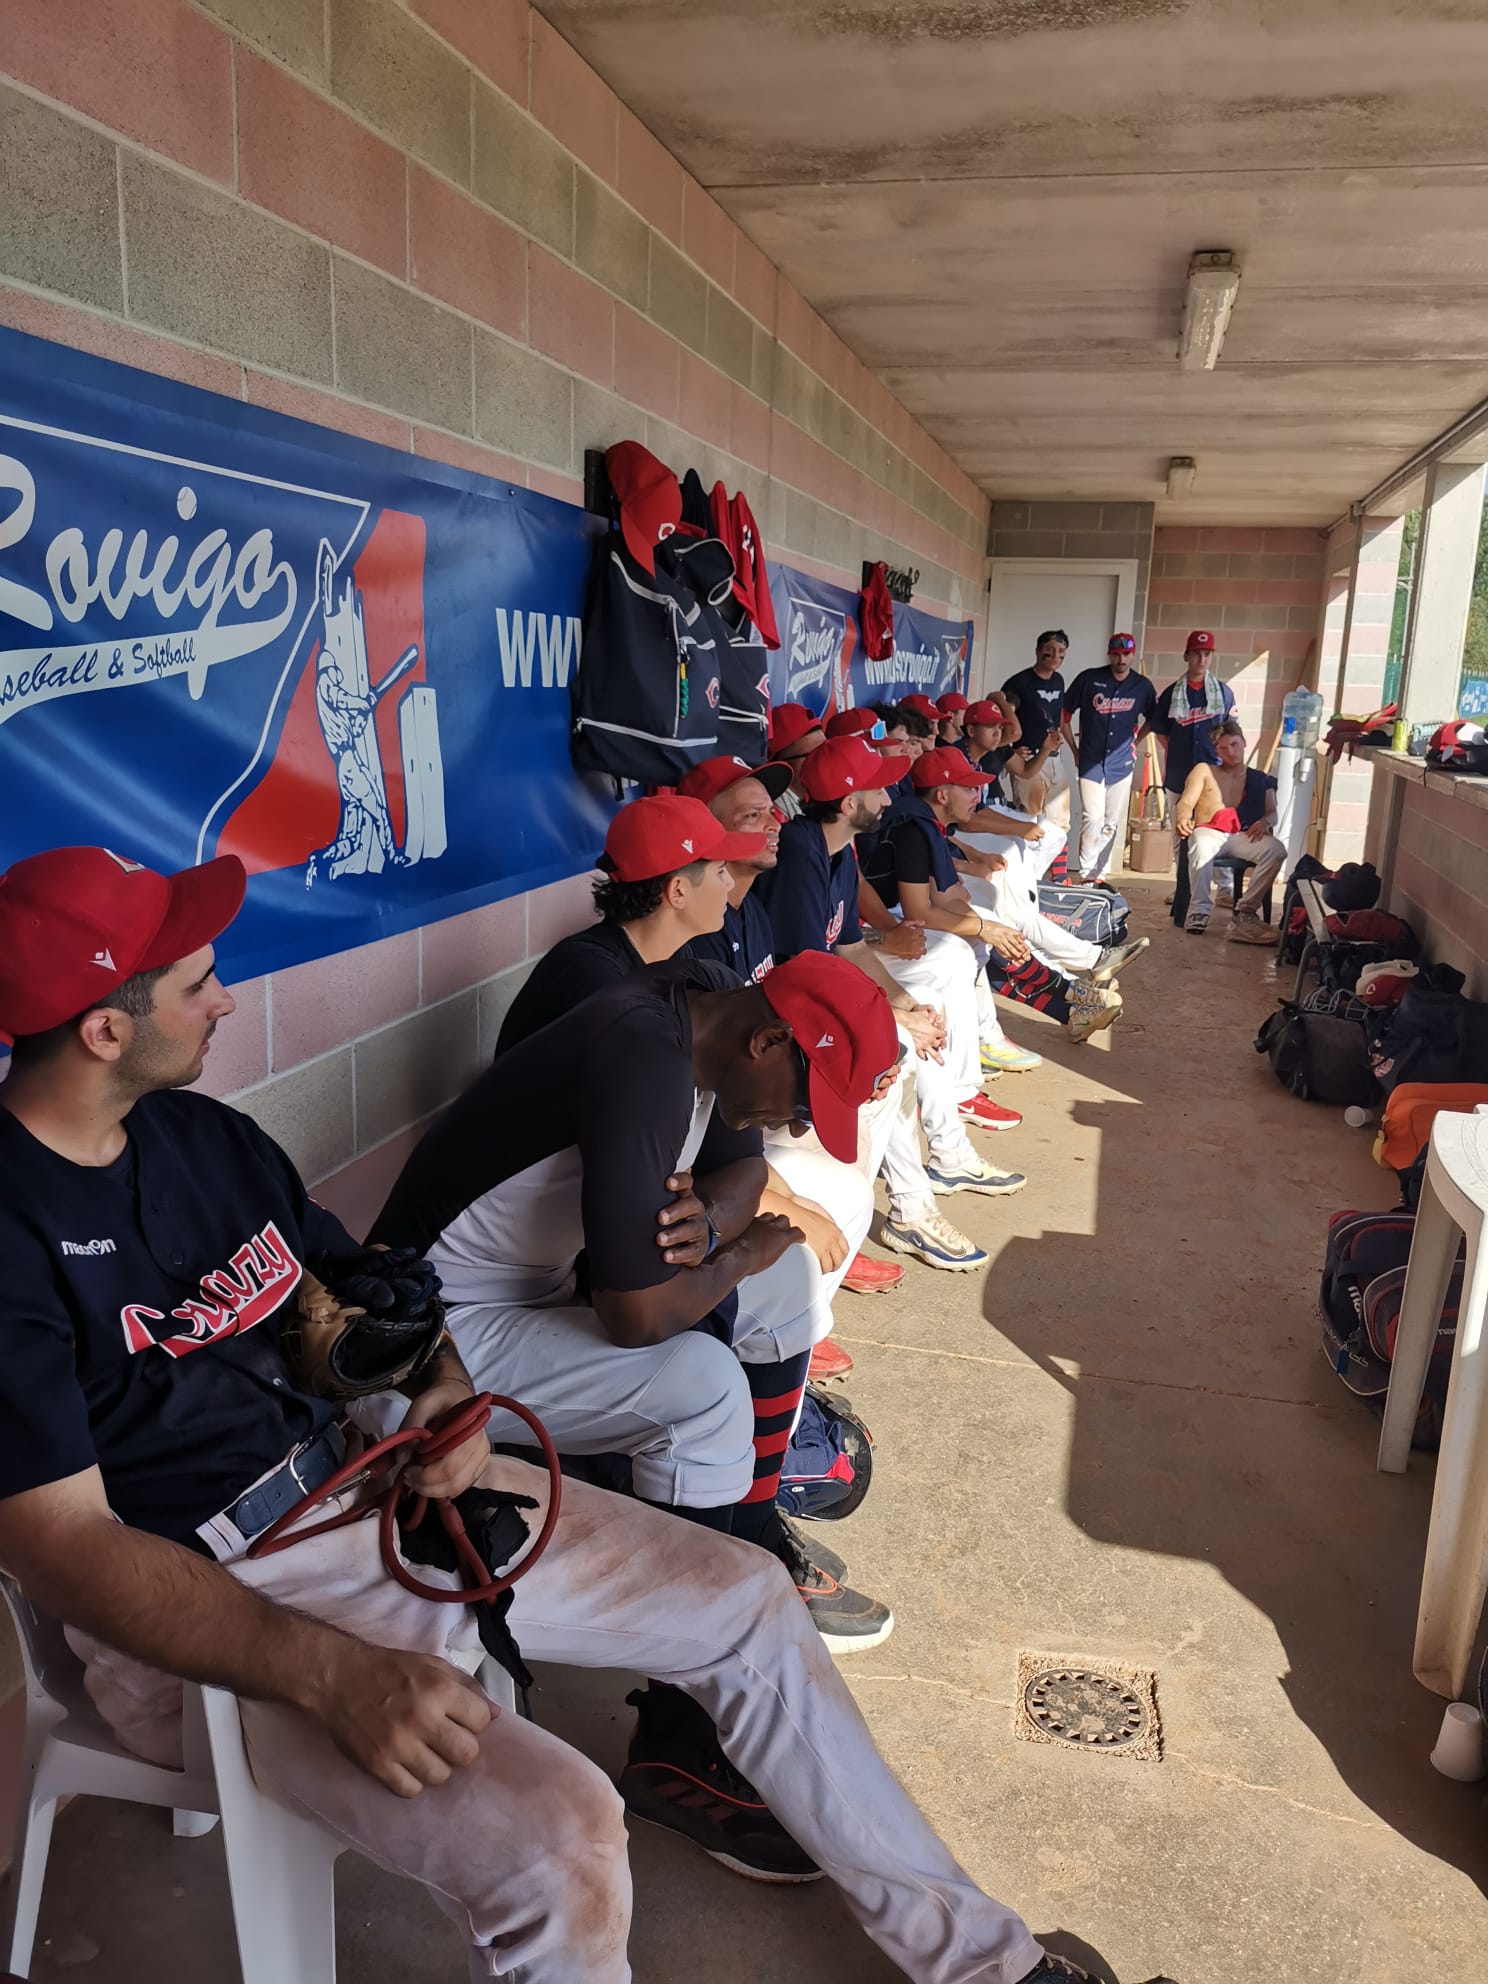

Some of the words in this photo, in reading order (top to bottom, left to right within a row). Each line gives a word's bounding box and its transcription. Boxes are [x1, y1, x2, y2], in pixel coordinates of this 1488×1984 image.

[0, 649, 98, 706] seball
[108, 648, 124, 679] &
[132, 636, 196, 678] Softball
[120, 1219, 303, 1359] Crazy
